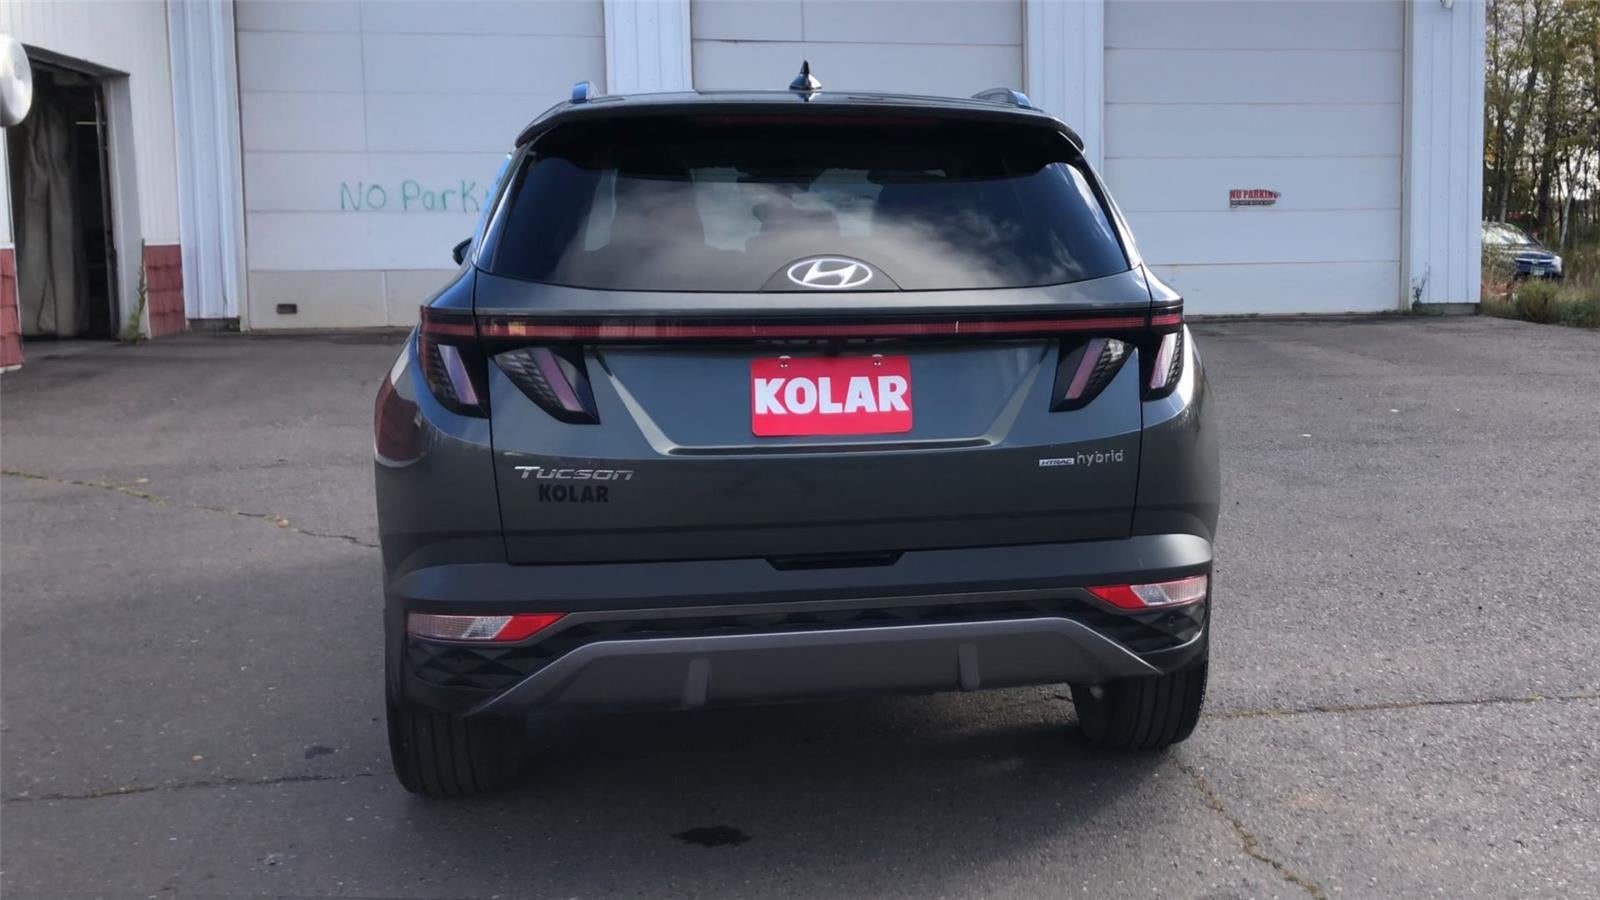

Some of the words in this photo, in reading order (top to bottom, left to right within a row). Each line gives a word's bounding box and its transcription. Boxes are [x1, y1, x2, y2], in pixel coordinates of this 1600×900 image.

[401, 179, 489, 213] ParK
[754, 375, 909, 415] KOLAR
[1076, 449, 1124, 466] hybrid
[538, 483, 609, 503] KOLAR
